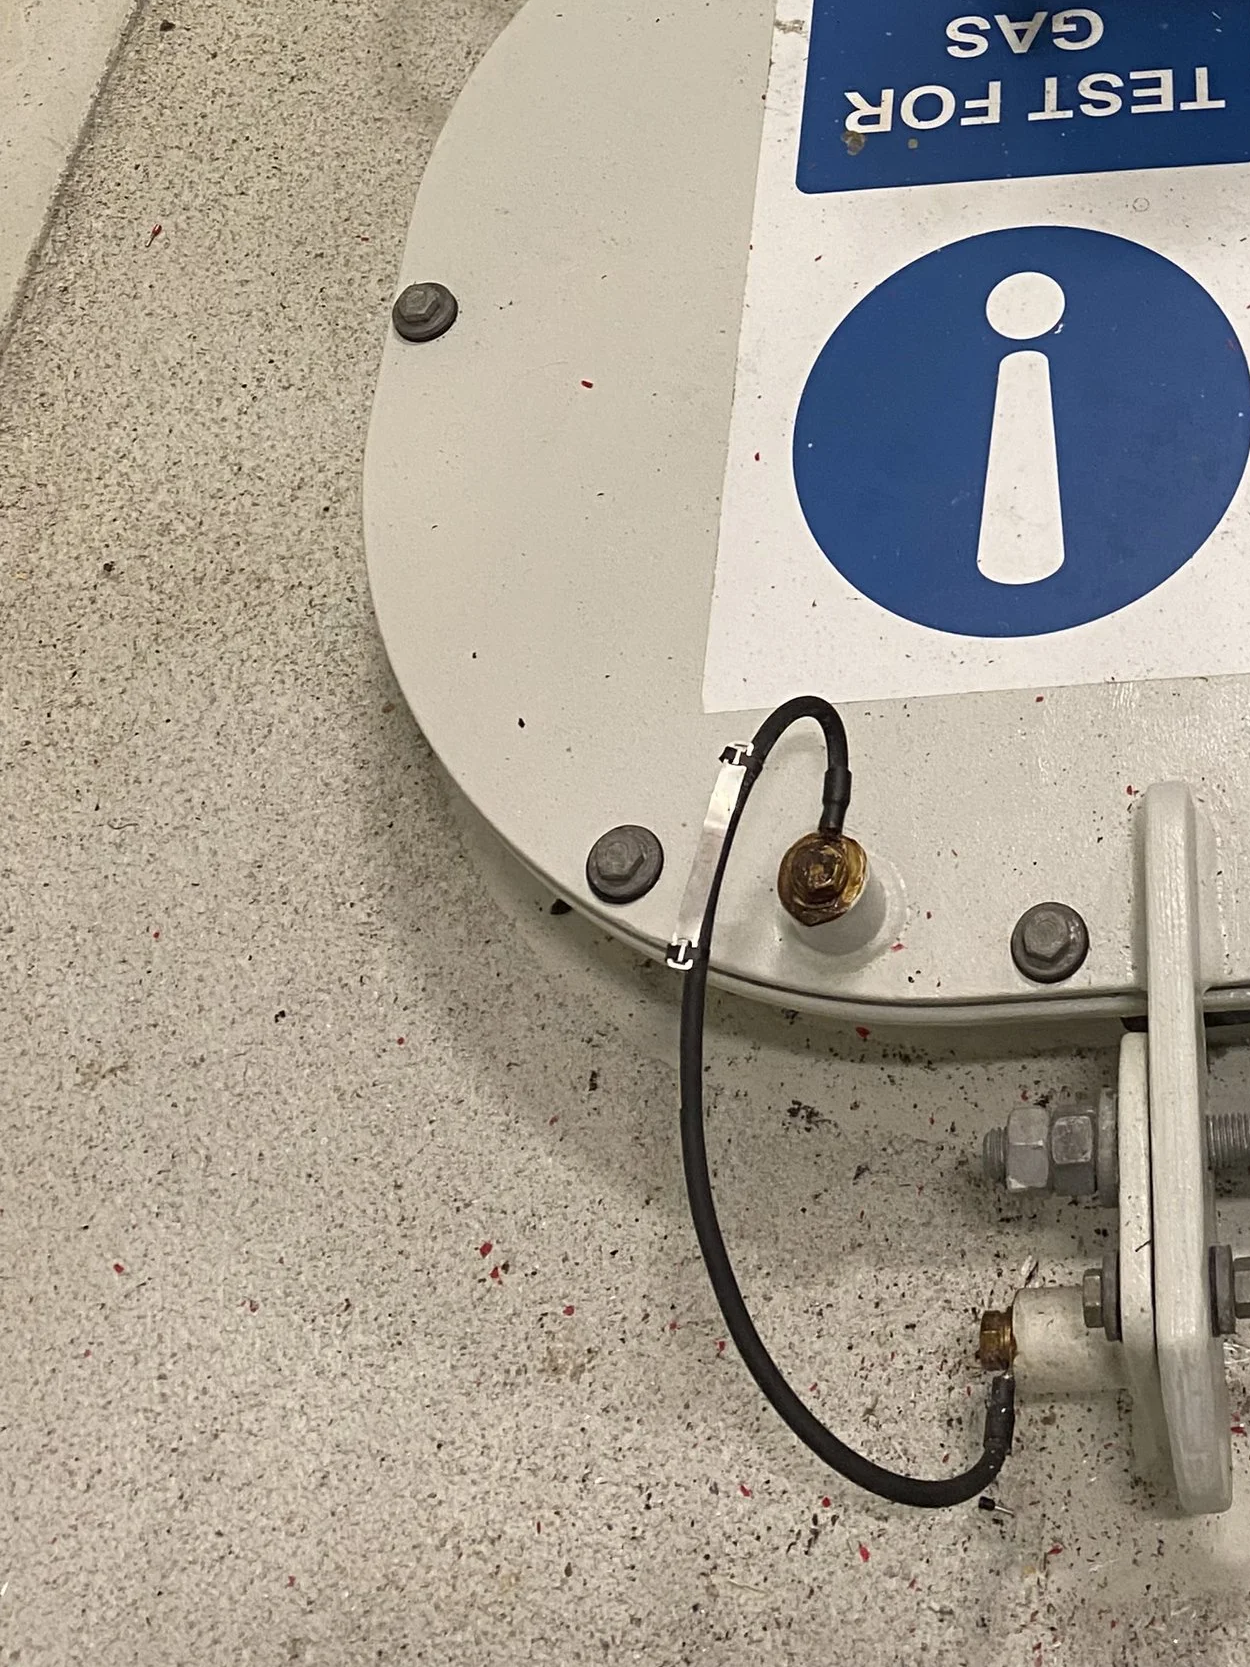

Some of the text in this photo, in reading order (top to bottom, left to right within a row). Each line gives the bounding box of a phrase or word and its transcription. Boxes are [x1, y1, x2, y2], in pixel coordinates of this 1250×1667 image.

[945, 8, 1105, 59] GAS
[843, 66, 1227, 133] TEST FOR
